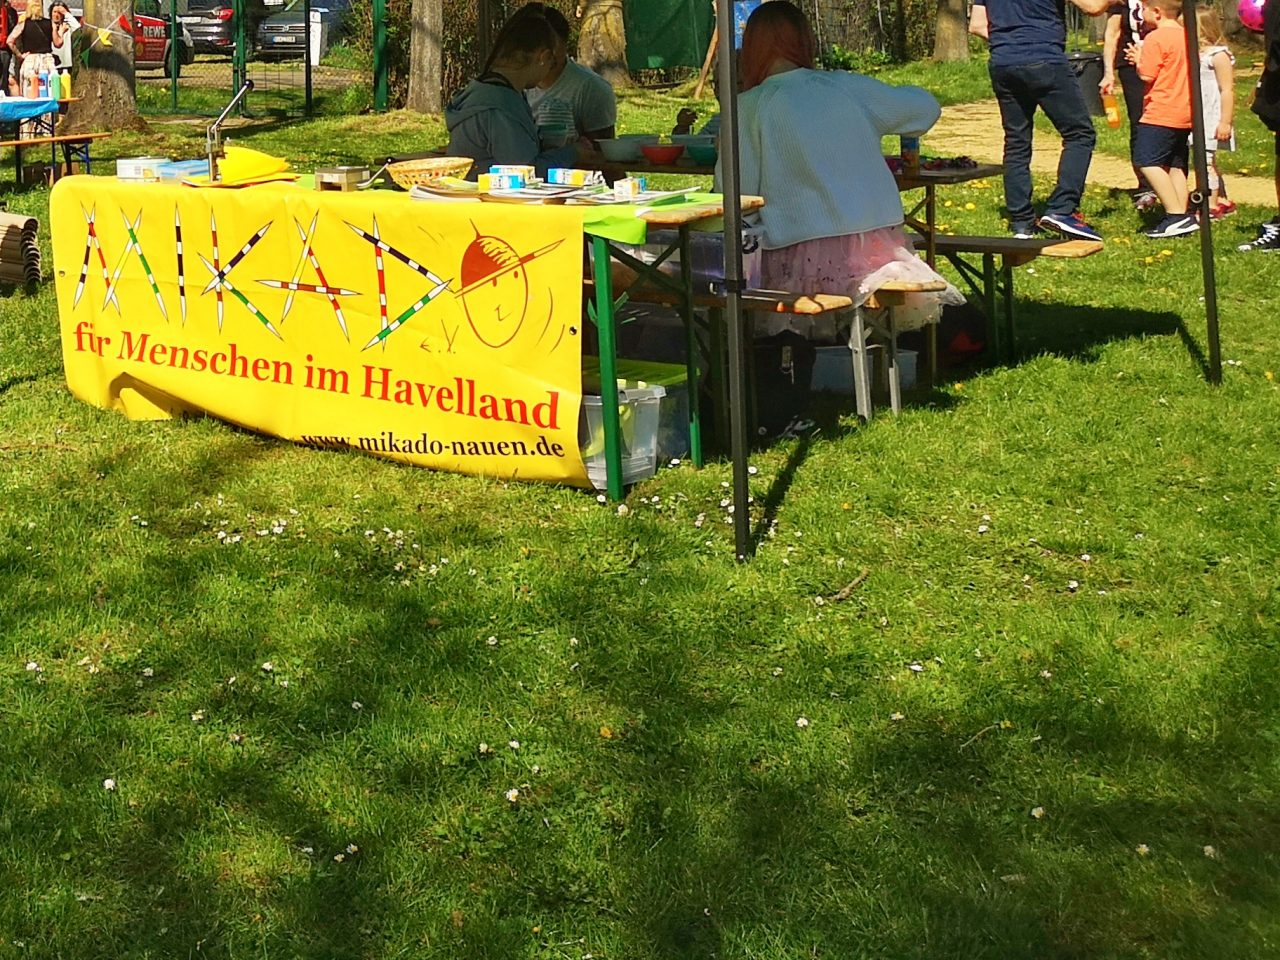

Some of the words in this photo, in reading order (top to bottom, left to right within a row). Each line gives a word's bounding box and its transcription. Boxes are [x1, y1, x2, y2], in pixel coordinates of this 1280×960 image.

[143, 25, 166, 38] REWE
[116, 330, 294, 385] Menschen
[303, 354, 350, 394] im
[361, 364, 561, 430] Havelland
